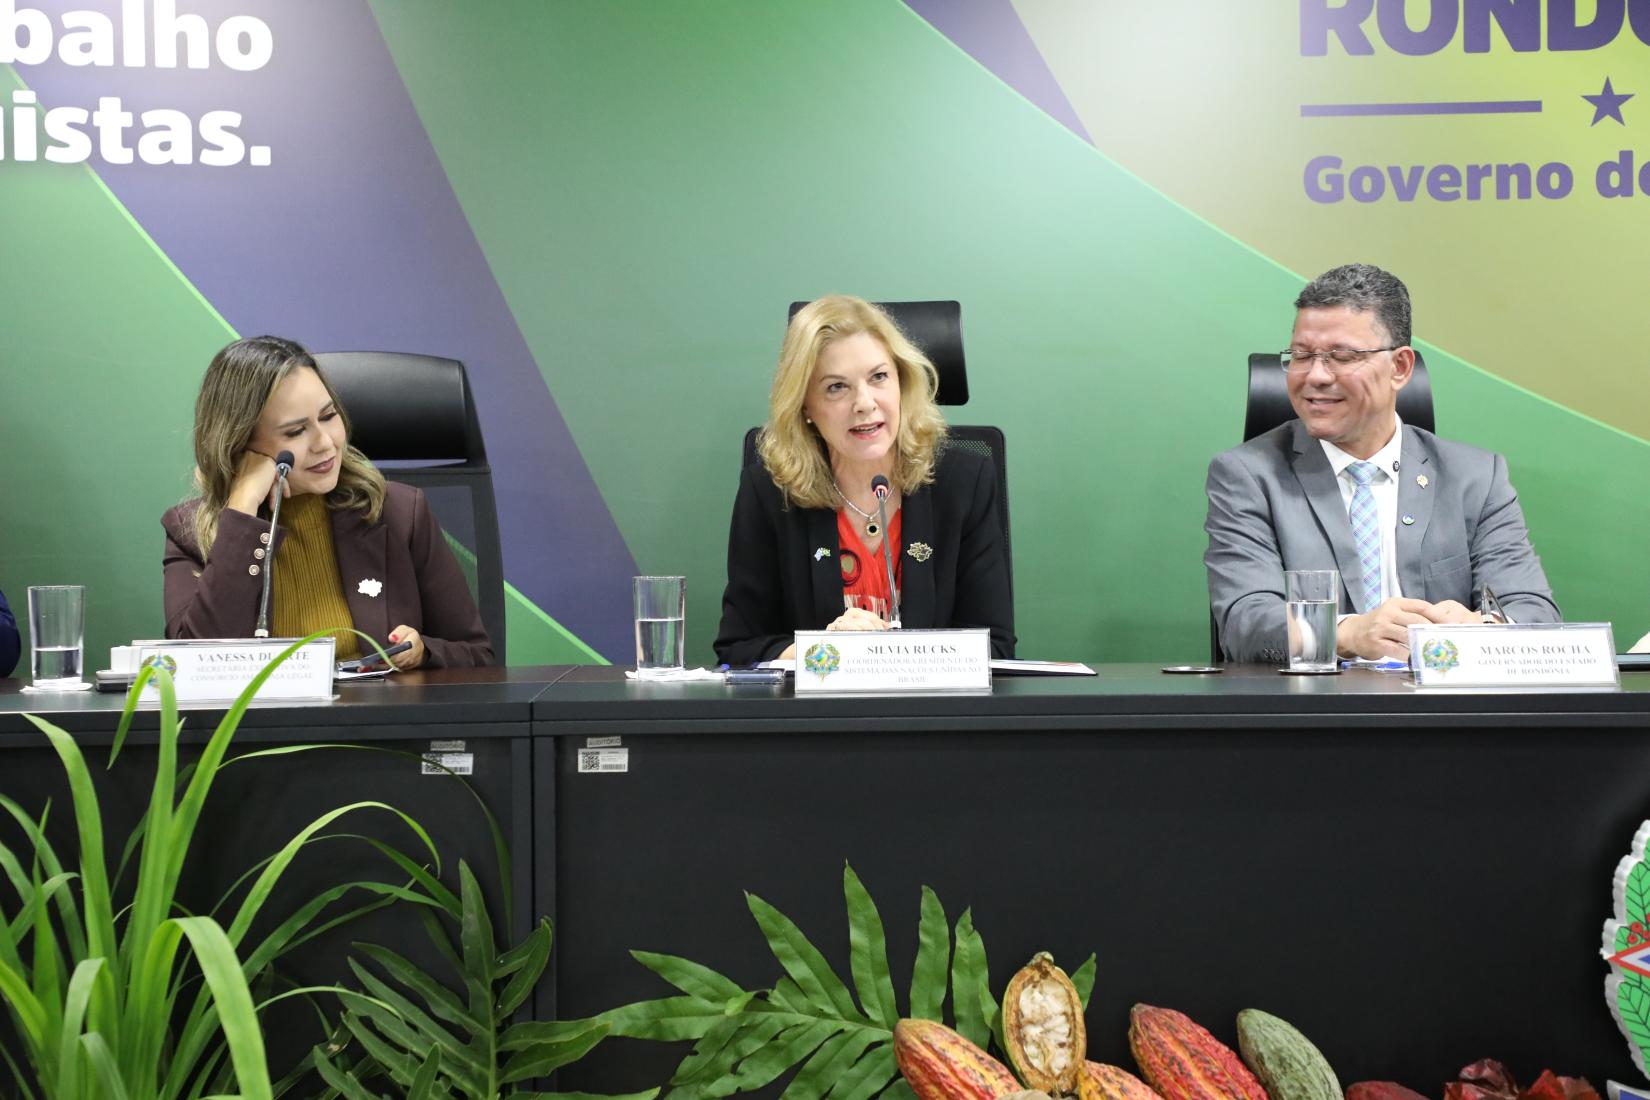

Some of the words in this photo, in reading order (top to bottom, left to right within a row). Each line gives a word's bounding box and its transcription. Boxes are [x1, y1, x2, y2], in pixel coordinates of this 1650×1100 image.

[0, 0, 273, 71] balho
[1299, 0, 1650, 56] ROND
[0, 90, 272, 167] istas.
[1303, 155, 1574, 204] Governo
[197, 653, 256, 662] VANESSA
[866, 645, 910, 655] SILVIA
[913, 644, 957, 654] RUCKS
[1479, 645, 1538, 655] MARCOS
[1542, 645, 1592, 655] ROCHA
[1506, 667, 1518, 675] DE
